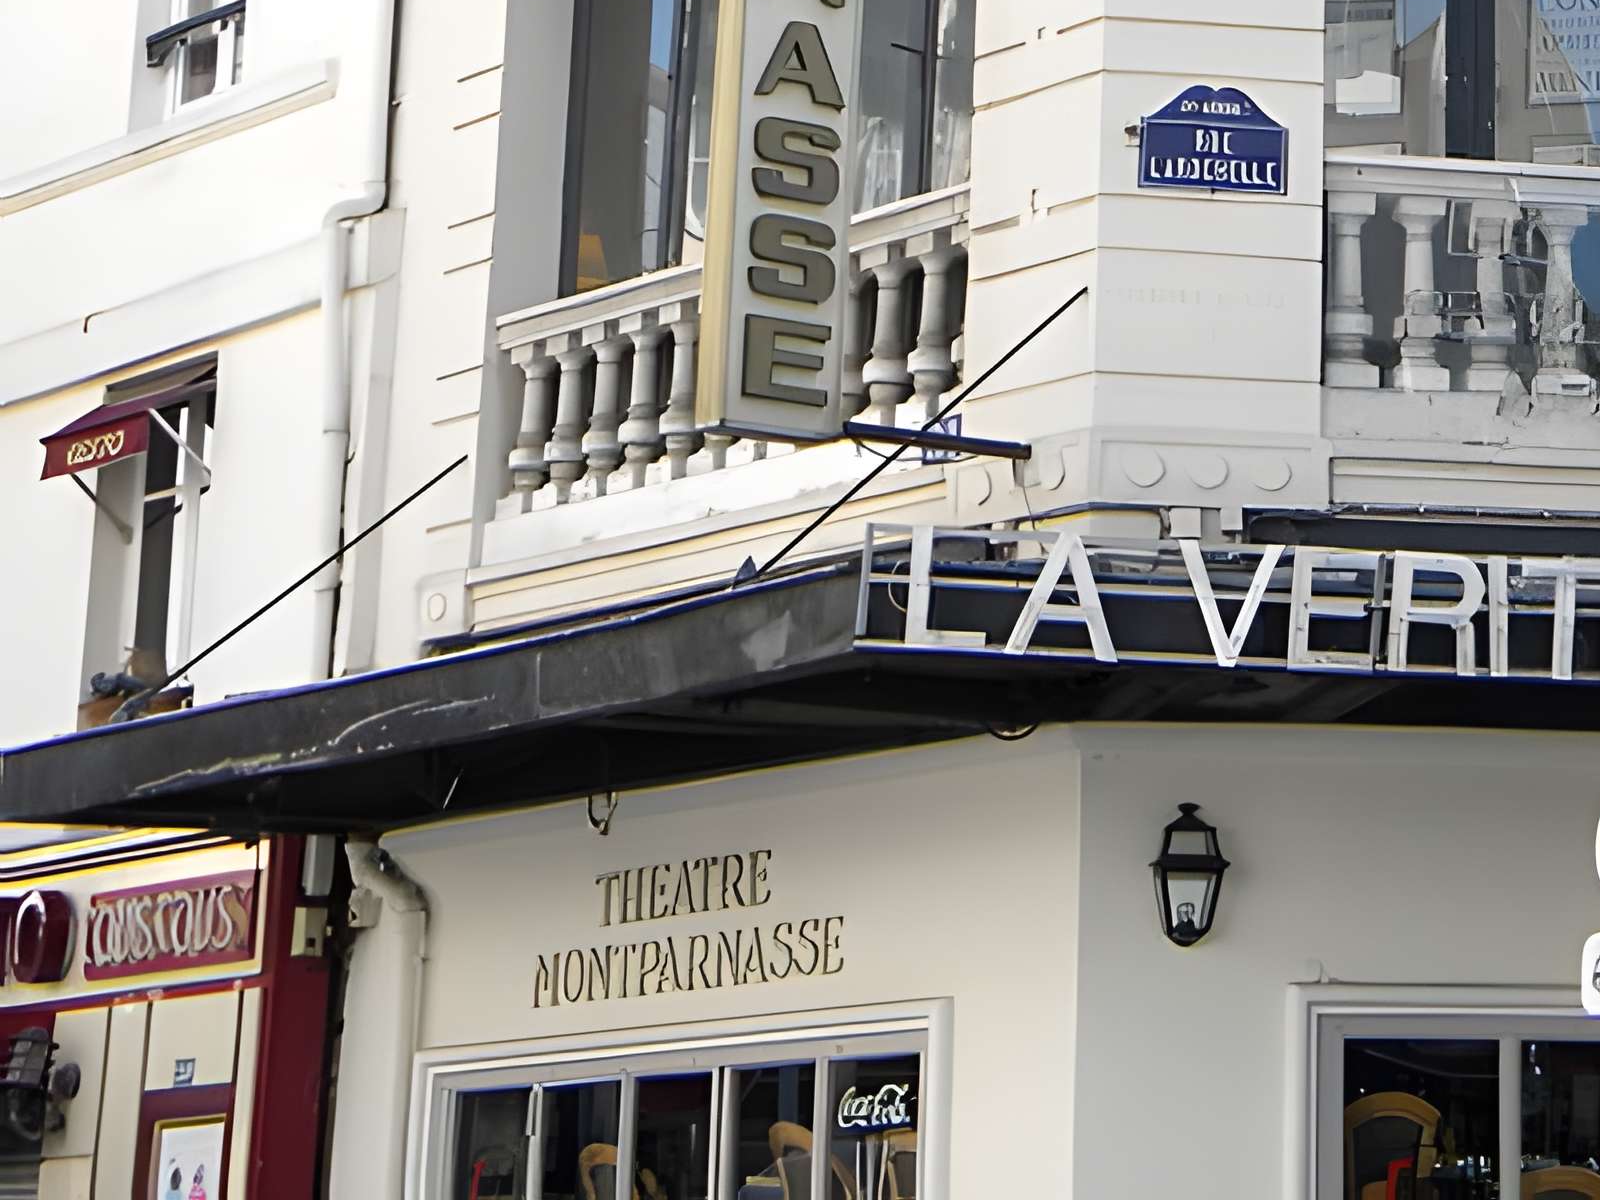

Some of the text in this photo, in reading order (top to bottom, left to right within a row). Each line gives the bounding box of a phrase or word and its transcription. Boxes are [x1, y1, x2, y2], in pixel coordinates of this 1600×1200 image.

[905, 524, 1118, 663] LA
[595, 849, 773, 928] THEATRE
[533, 915, 845, 1009] MONTPARNASSE
